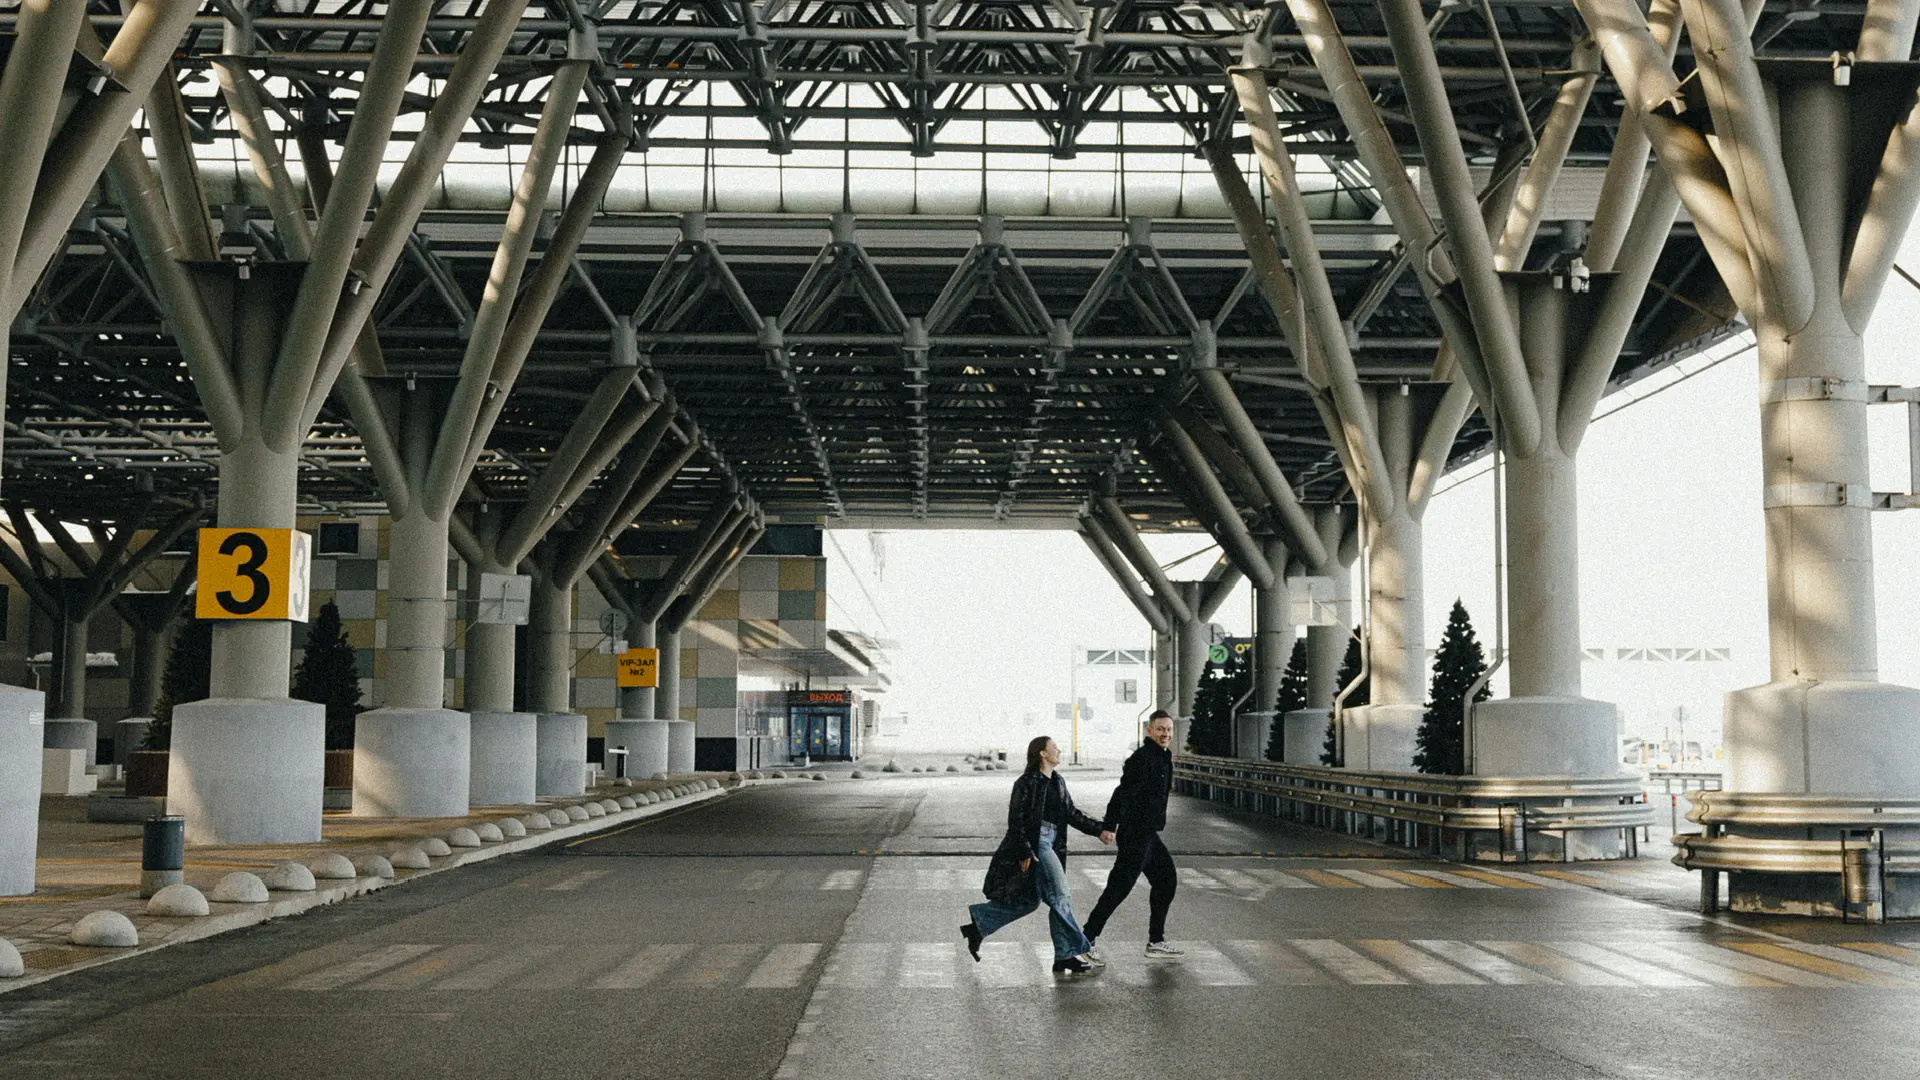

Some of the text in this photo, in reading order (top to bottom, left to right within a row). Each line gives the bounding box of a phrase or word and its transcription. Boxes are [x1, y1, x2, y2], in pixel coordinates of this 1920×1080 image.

[216, 532, 270, 615] 3
[293, 536, 306, 618] 3
[809, 693, 843, 702] ВЫХОД
